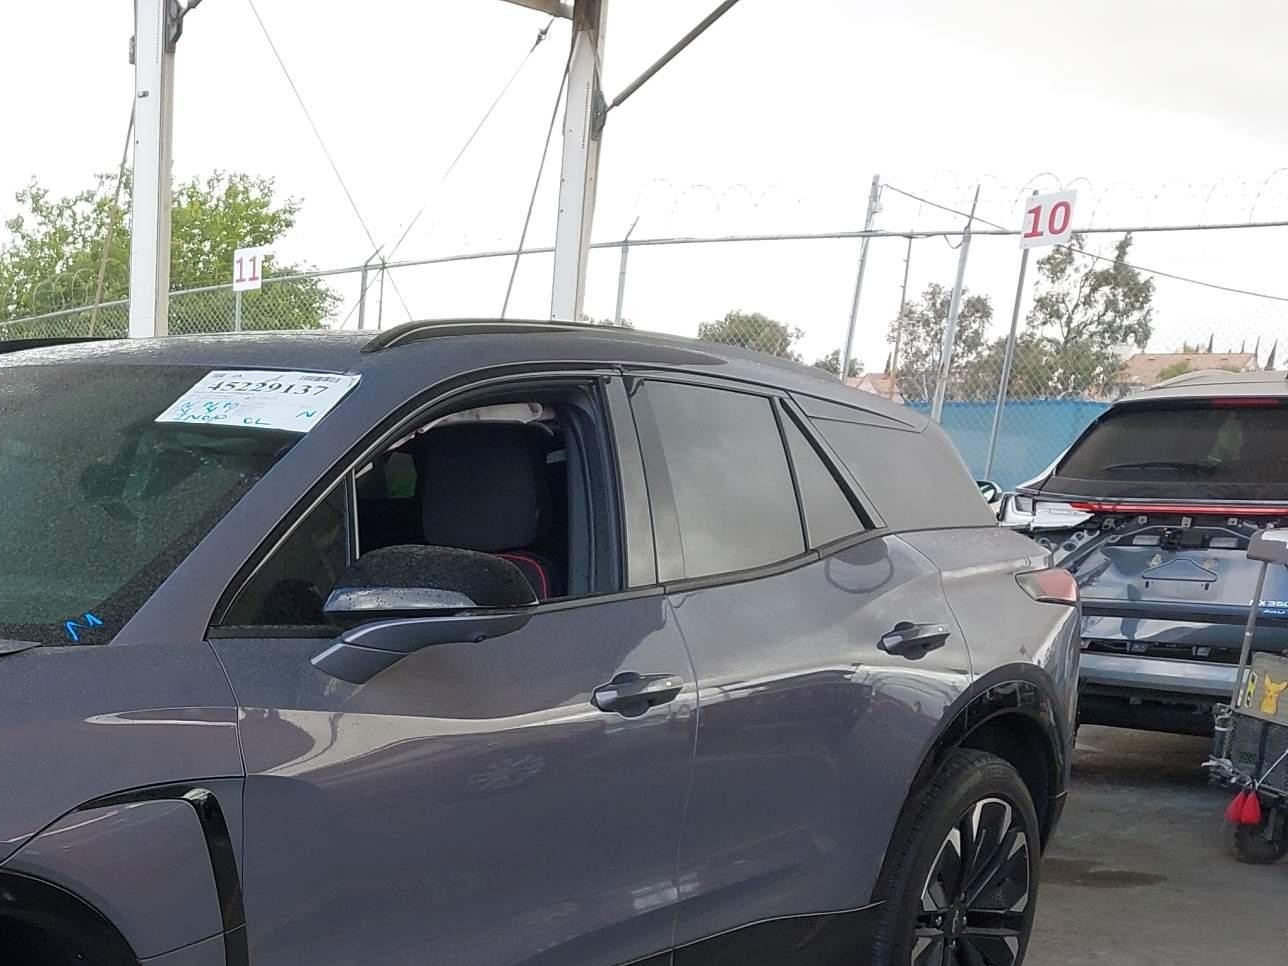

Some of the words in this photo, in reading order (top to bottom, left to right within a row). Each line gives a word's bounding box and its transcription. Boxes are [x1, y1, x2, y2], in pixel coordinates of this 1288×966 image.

[1023, 201, 1071, 238] 10
[236, 255, 259, 283] 11
[208, 380, 329, 395] 45229137
